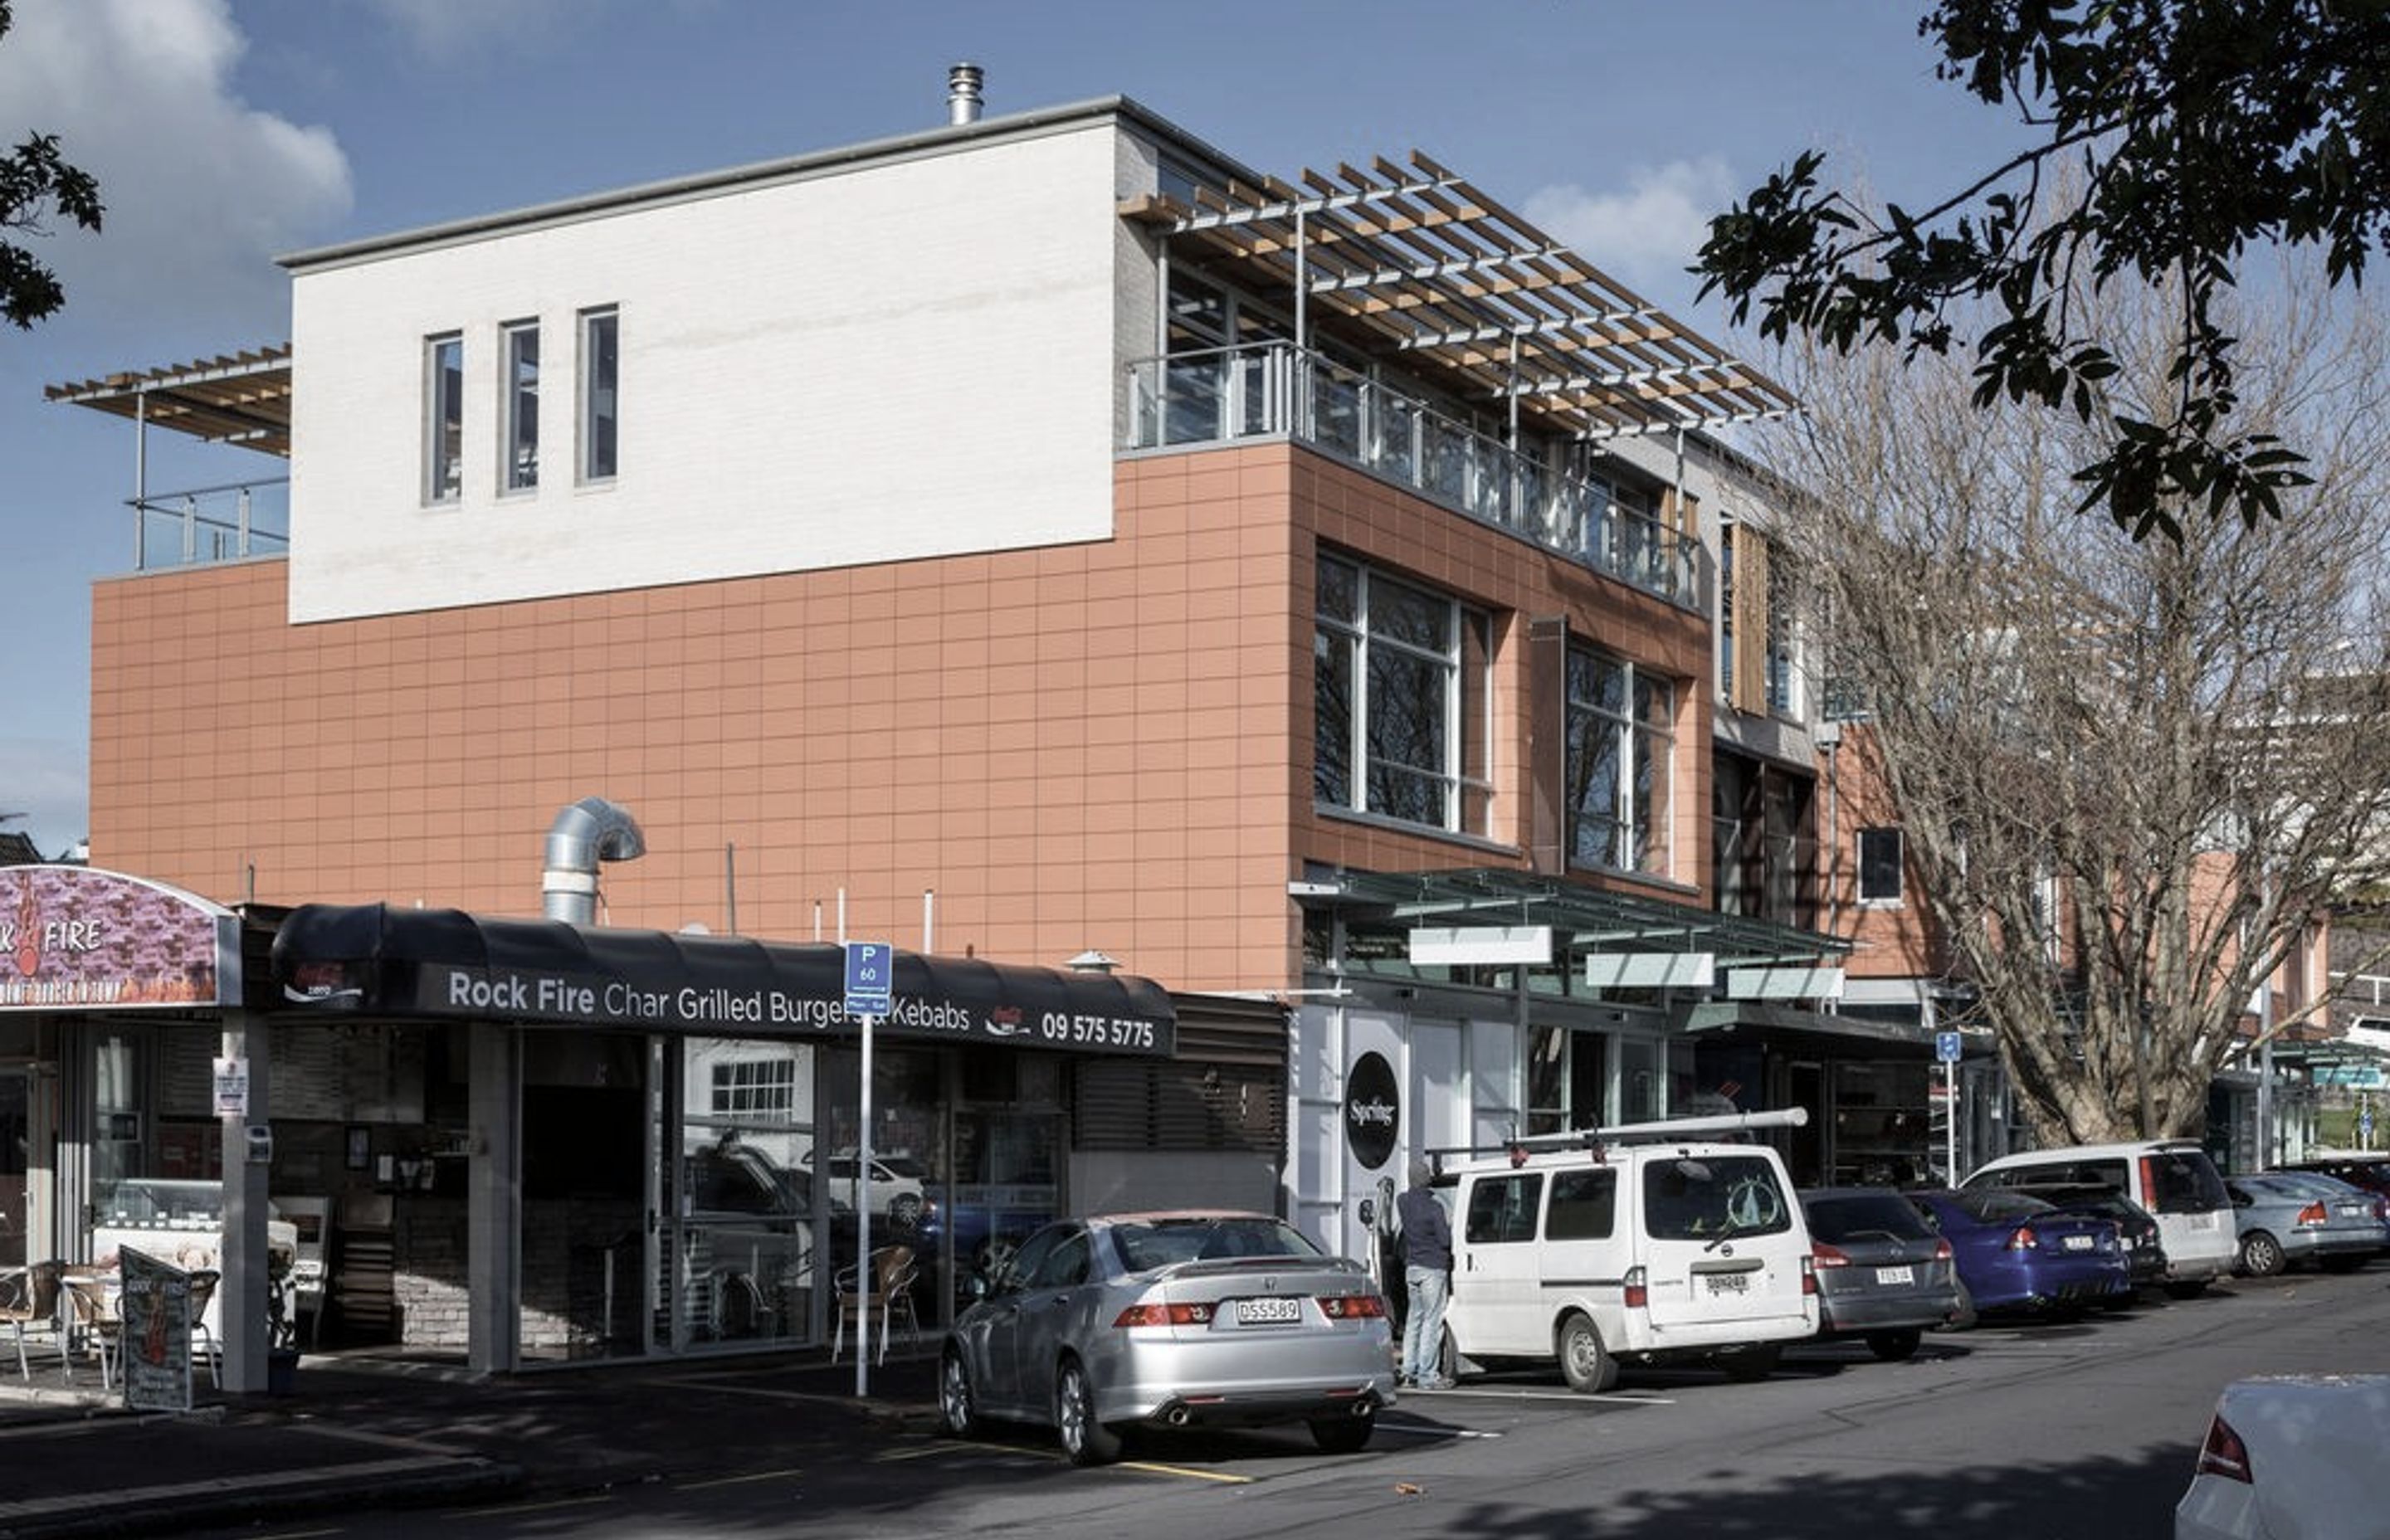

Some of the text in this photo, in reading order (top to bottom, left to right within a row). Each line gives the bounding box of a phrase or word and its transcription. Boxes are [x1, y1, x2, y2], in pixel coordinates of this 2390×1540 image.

[45, 919, 102, 952] FIRE
[862, 946, 876, 962] P
[860, 967, 876, 981] 60
[450, 972, 529, 1010] Rock
[539, 978, 595, 1014] Fire
[604, 983, 669, 1017] Char
[678, 987, 762, 1021] Grilled
[891, 997, 970, 1031] Kebabs
[1041, 1011, 1068, 1040] 09
[1073, 1015, 1106, 1043] 575
[1111, 1018, 1154, 1047] 5775
[1350, 1094, 1397, 1127] Spring
[1239, 1301, 1297, 1318] DSS589
